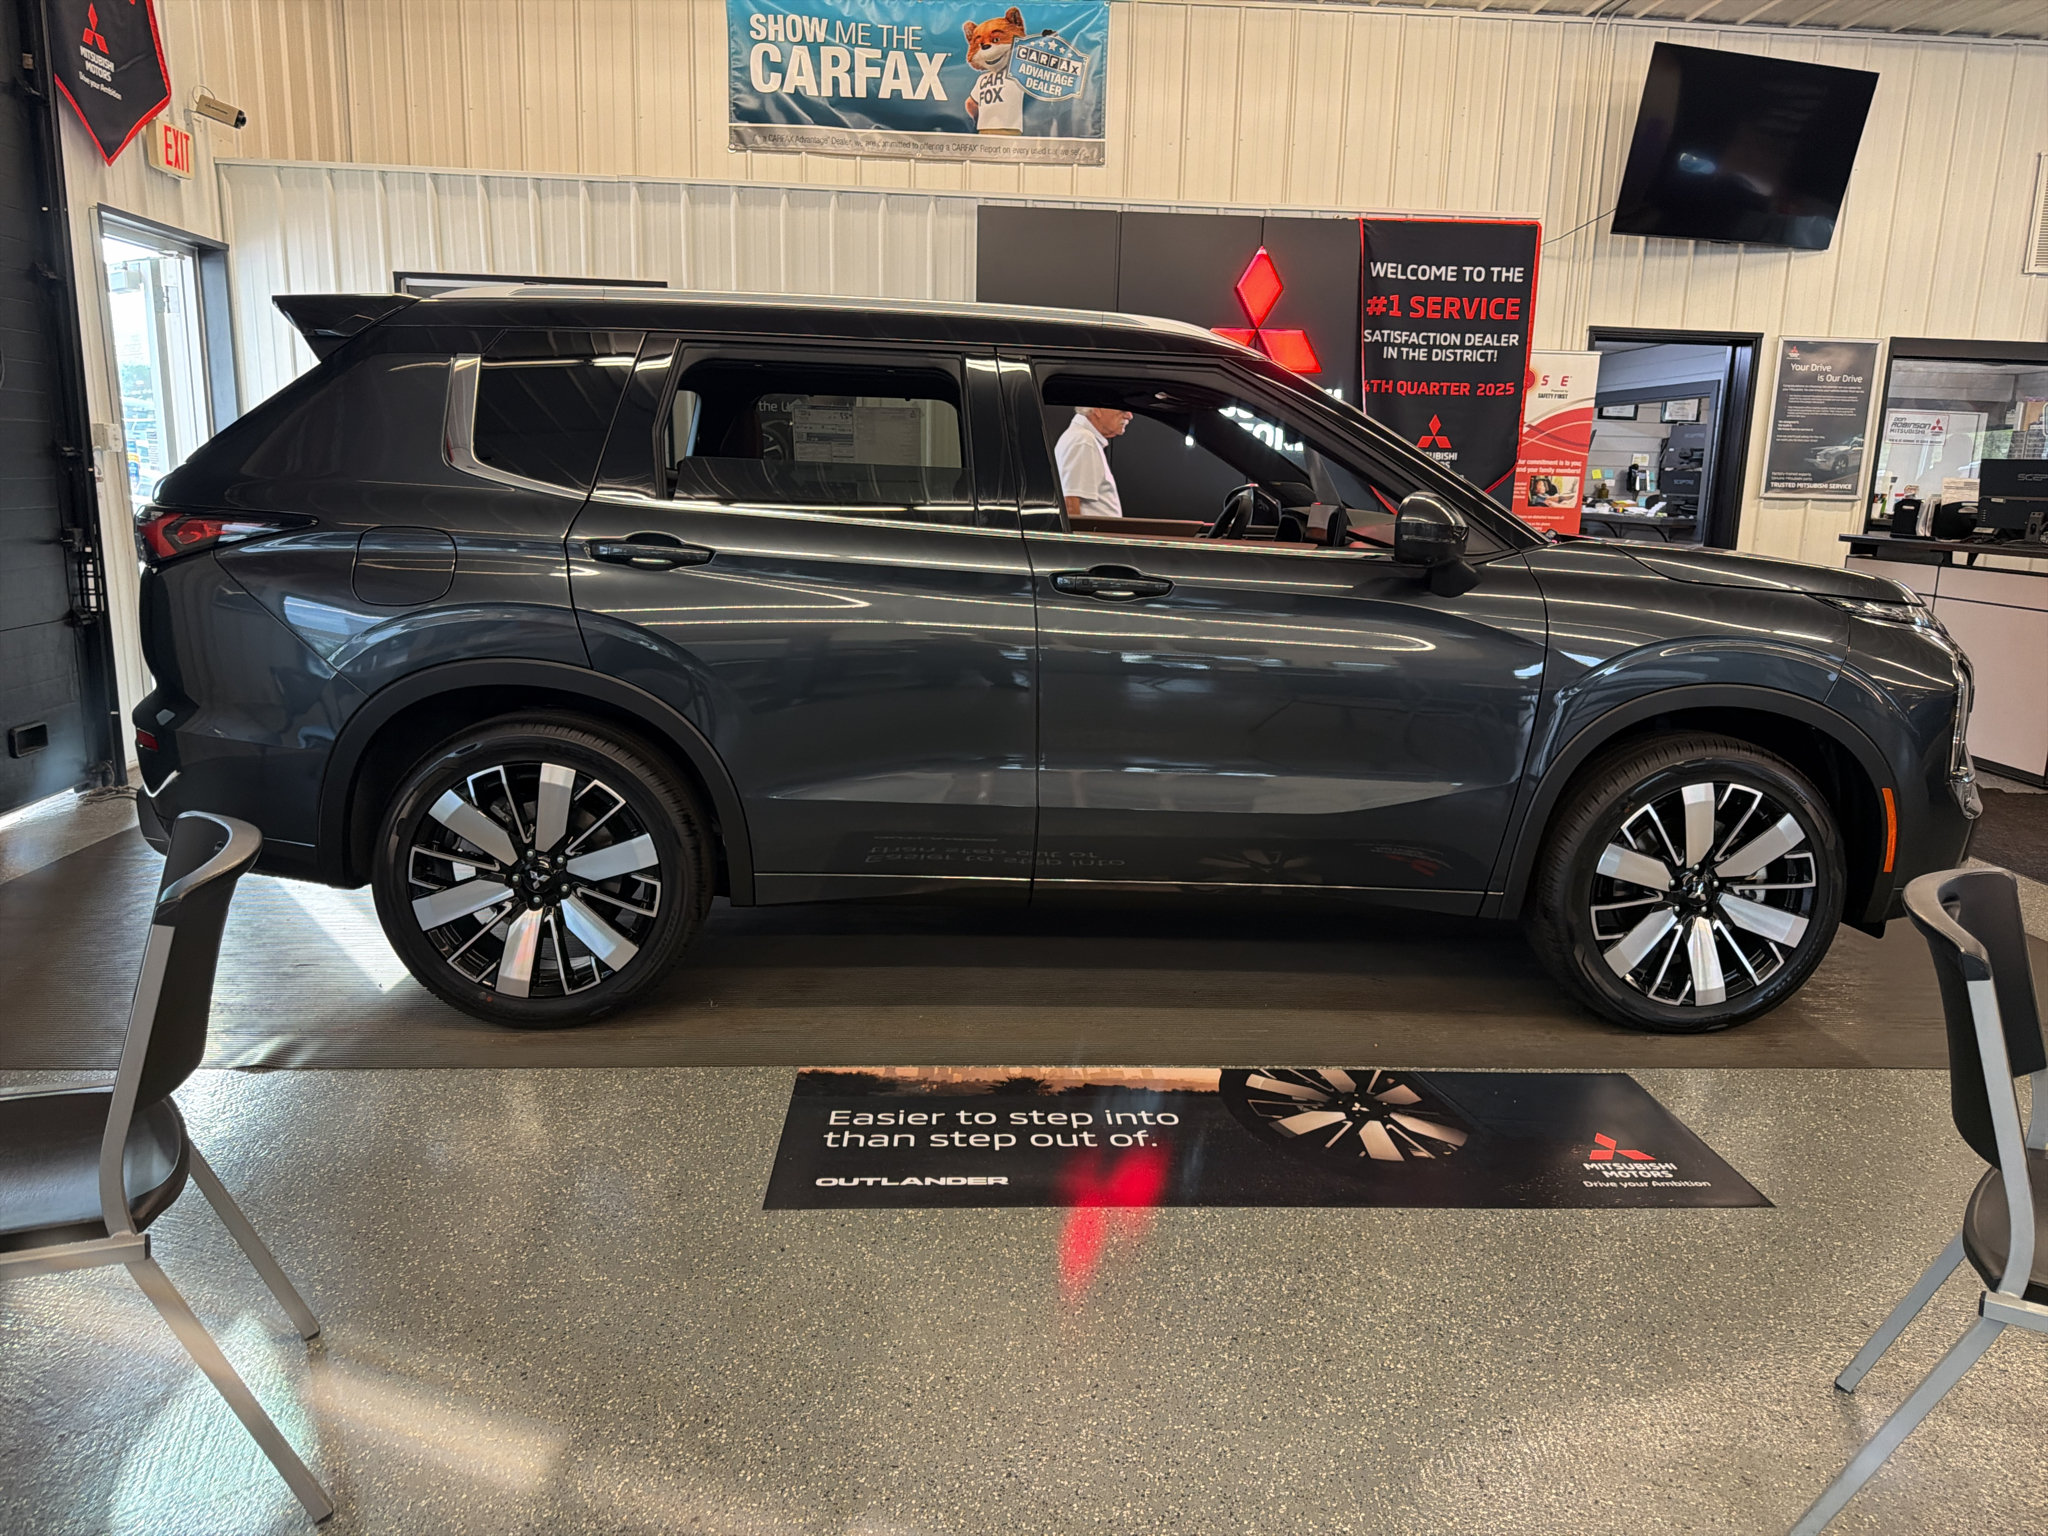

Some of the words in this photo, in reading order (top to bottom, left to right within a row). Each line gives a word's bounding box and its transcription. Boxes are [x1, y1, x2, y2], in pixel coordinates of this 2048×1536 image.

[750, 14, 828, 44] SHOW
[836, 20, 874, 45] ME
[878, 24, 922, 50] THE
[80, 46, 114, 72] MITSUBISHI
[1018, 46, 1080, 74] CARFAX
[85, 61, 112, 82] MOTORS
[750, 43, 948, 100] CARFAX
[980, 71, 1004, 90] CAR
[1019, 63, 1074, 86] ADVANTAGE
[980, 87, 1004, 106] FOX
[1026, 78, 1062, 96] DEALER
[164, 124, 190, 174] EXIT
[920, 142, 944, 151] offering
[980, 144, 1000, 154] Report
[1370, 262, 1458, 282] WELCOME
[1463, 266, 1486, 282] TO
[1490, 266, 1524, 283] THE
[1366, 294, 1402, 317] #1
[1410, 296, 1520, 320] SERVICE
[1364, 330, 1461, 346] SATISFACTION
[1465, 333, 1519, 348] DEALER
[1383, 346, 1398, 360] IN
[1401, 347, 1428, 361] THE
[1432, 348, 1498, 362] DISTRICT!
[1791, 362, 1810, 372] Your
[1811, 363, 1832, 372] Drive
[1396, 380, 1470, 396] QUARTER
[1476, 382, 1516, 396] 2025
[1818, 374, 1824, 382] is
[1826, 374, 1840, 382] Our
[1842, 374, 1863, 383] Drive
[758, 400, 778, 412] the
[829, 1110, 945, 1126] Easier
[956, 1110, 996, 1126] to
[1010, 1110, 1093, 1129] step
[1105, 1109, 1180, 1126] into
[824, 1130, 915, 1148] than
[930, 1130, 1016, 1151] step
[1030, 1132, 1098, 1148] out
[1109, 1130, 1158, 1148] of.
[1582, 1162, 1678, 1170] MITSUBISHI
[1602, 1170, 1674, 1178] MOTORS
[815, 1176, 1009, 1186] OUTLANDER
